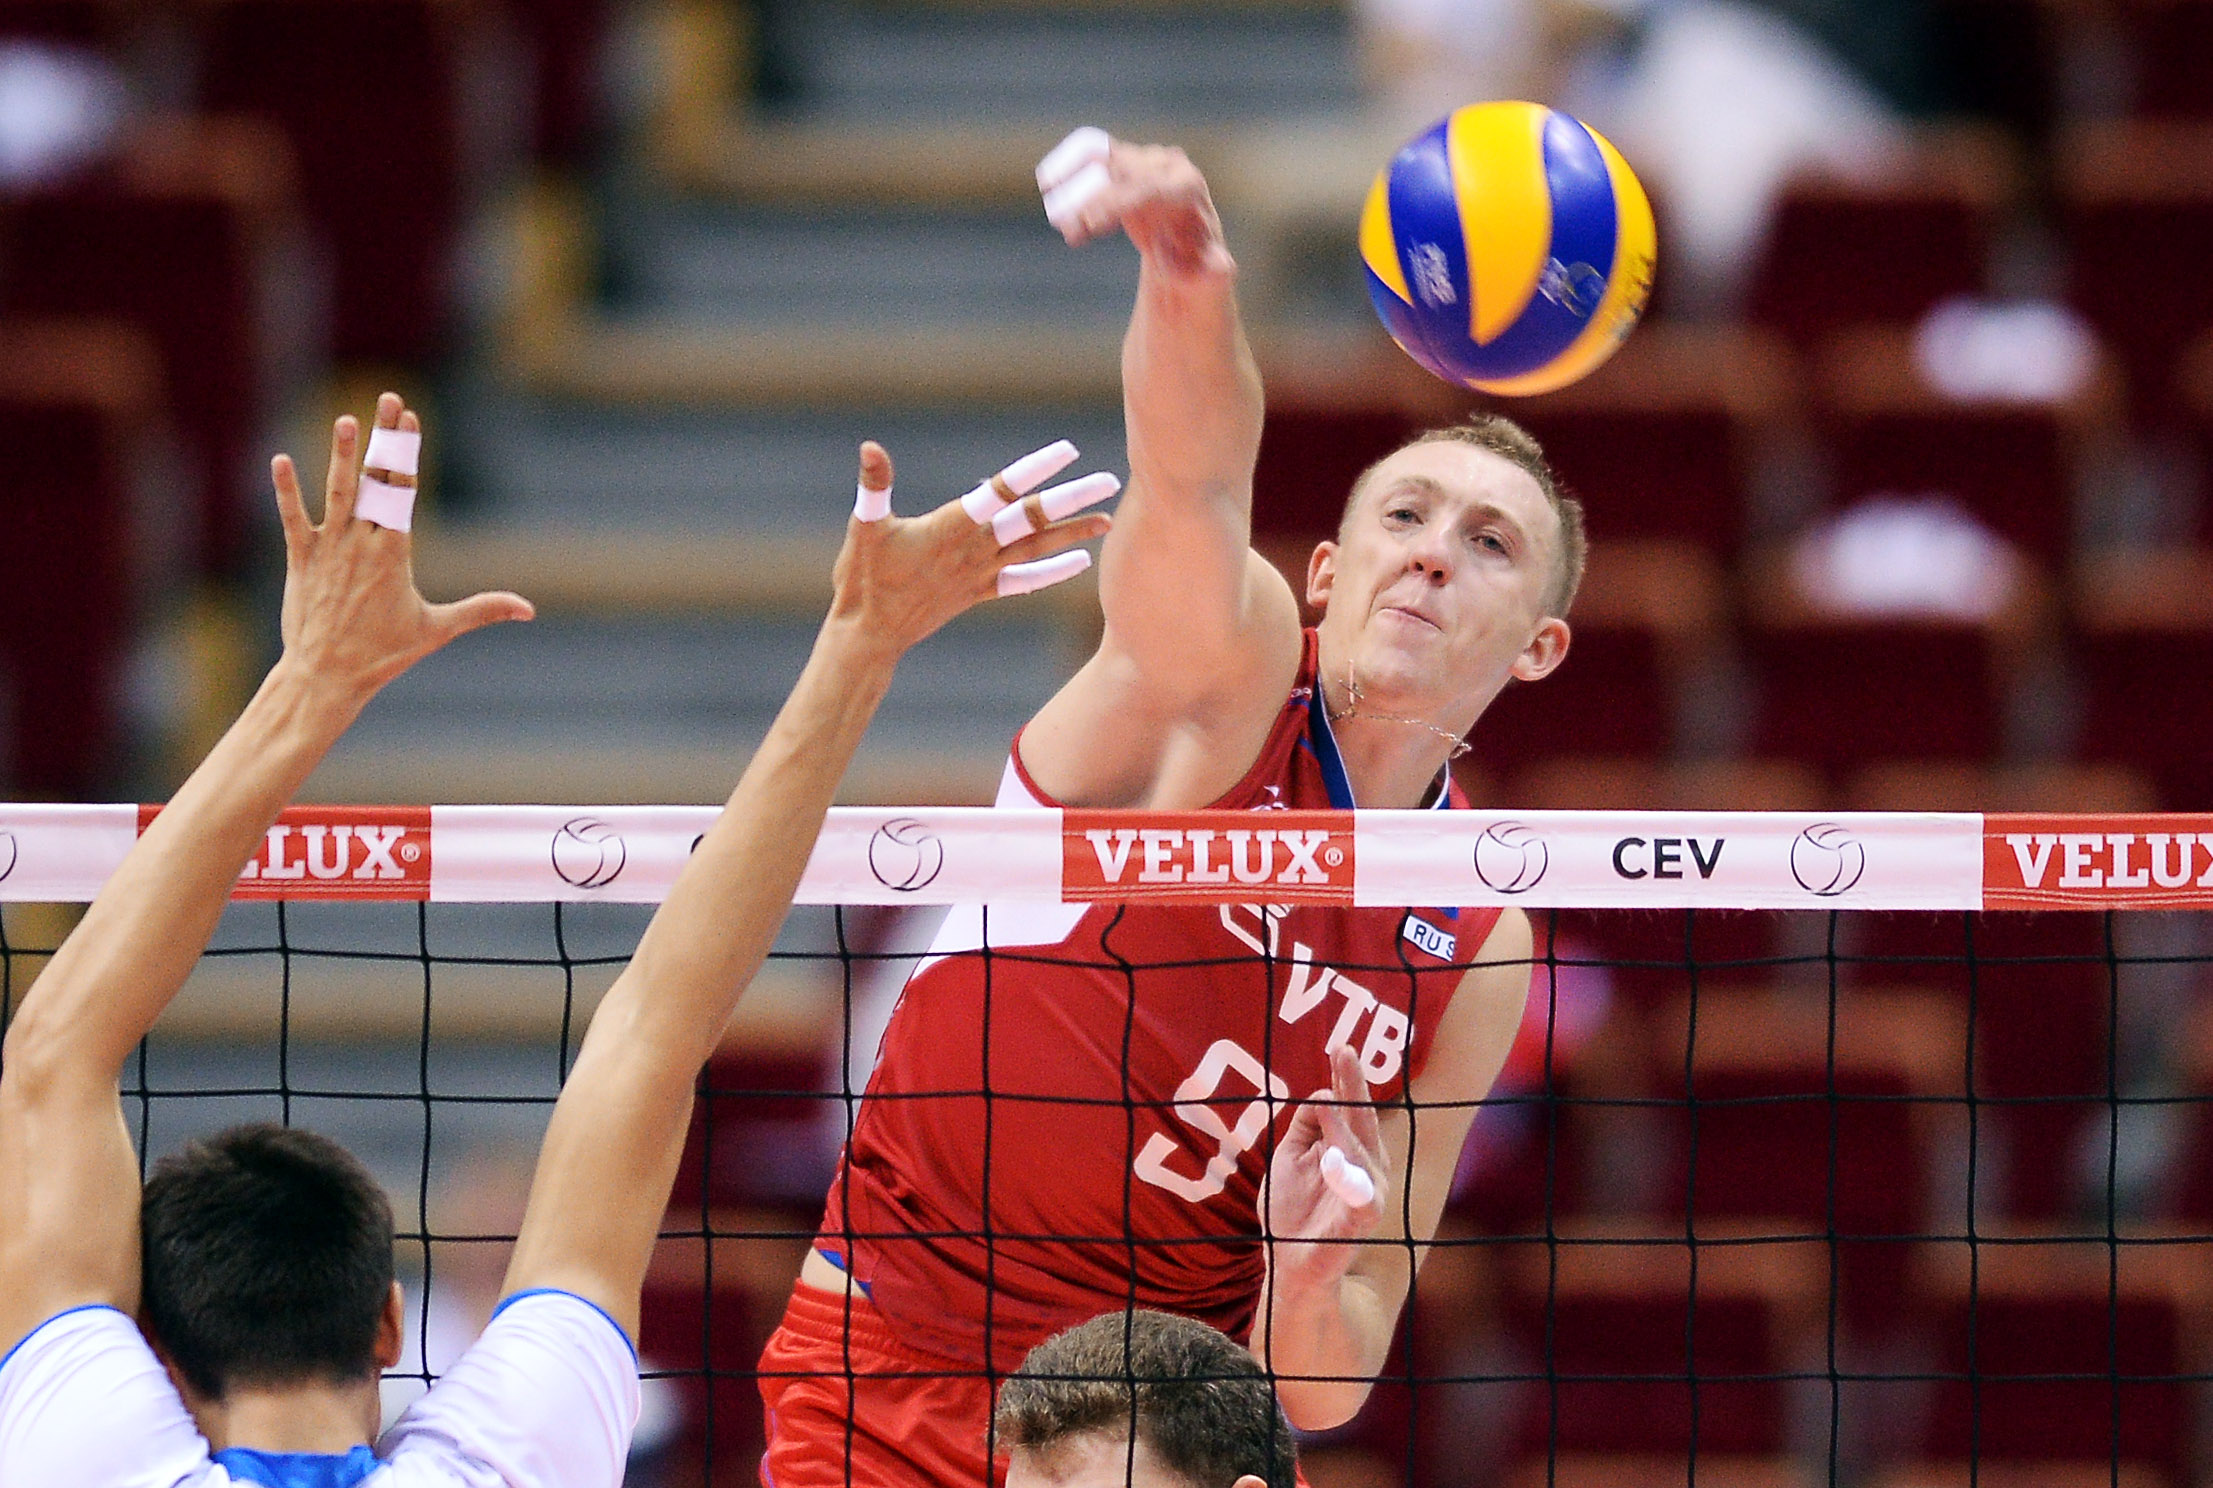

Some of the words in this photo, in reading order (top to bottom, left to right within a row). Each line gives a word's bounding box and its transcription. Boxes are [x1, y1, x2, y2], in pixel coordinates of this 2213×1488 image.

[1612, 836, 1726, 880] CEV
[1413, 923, 1456, 959] RUS
[1278, 941, 1415, 1085] VTB
[1133, 1038, 1290, 1203] 9
